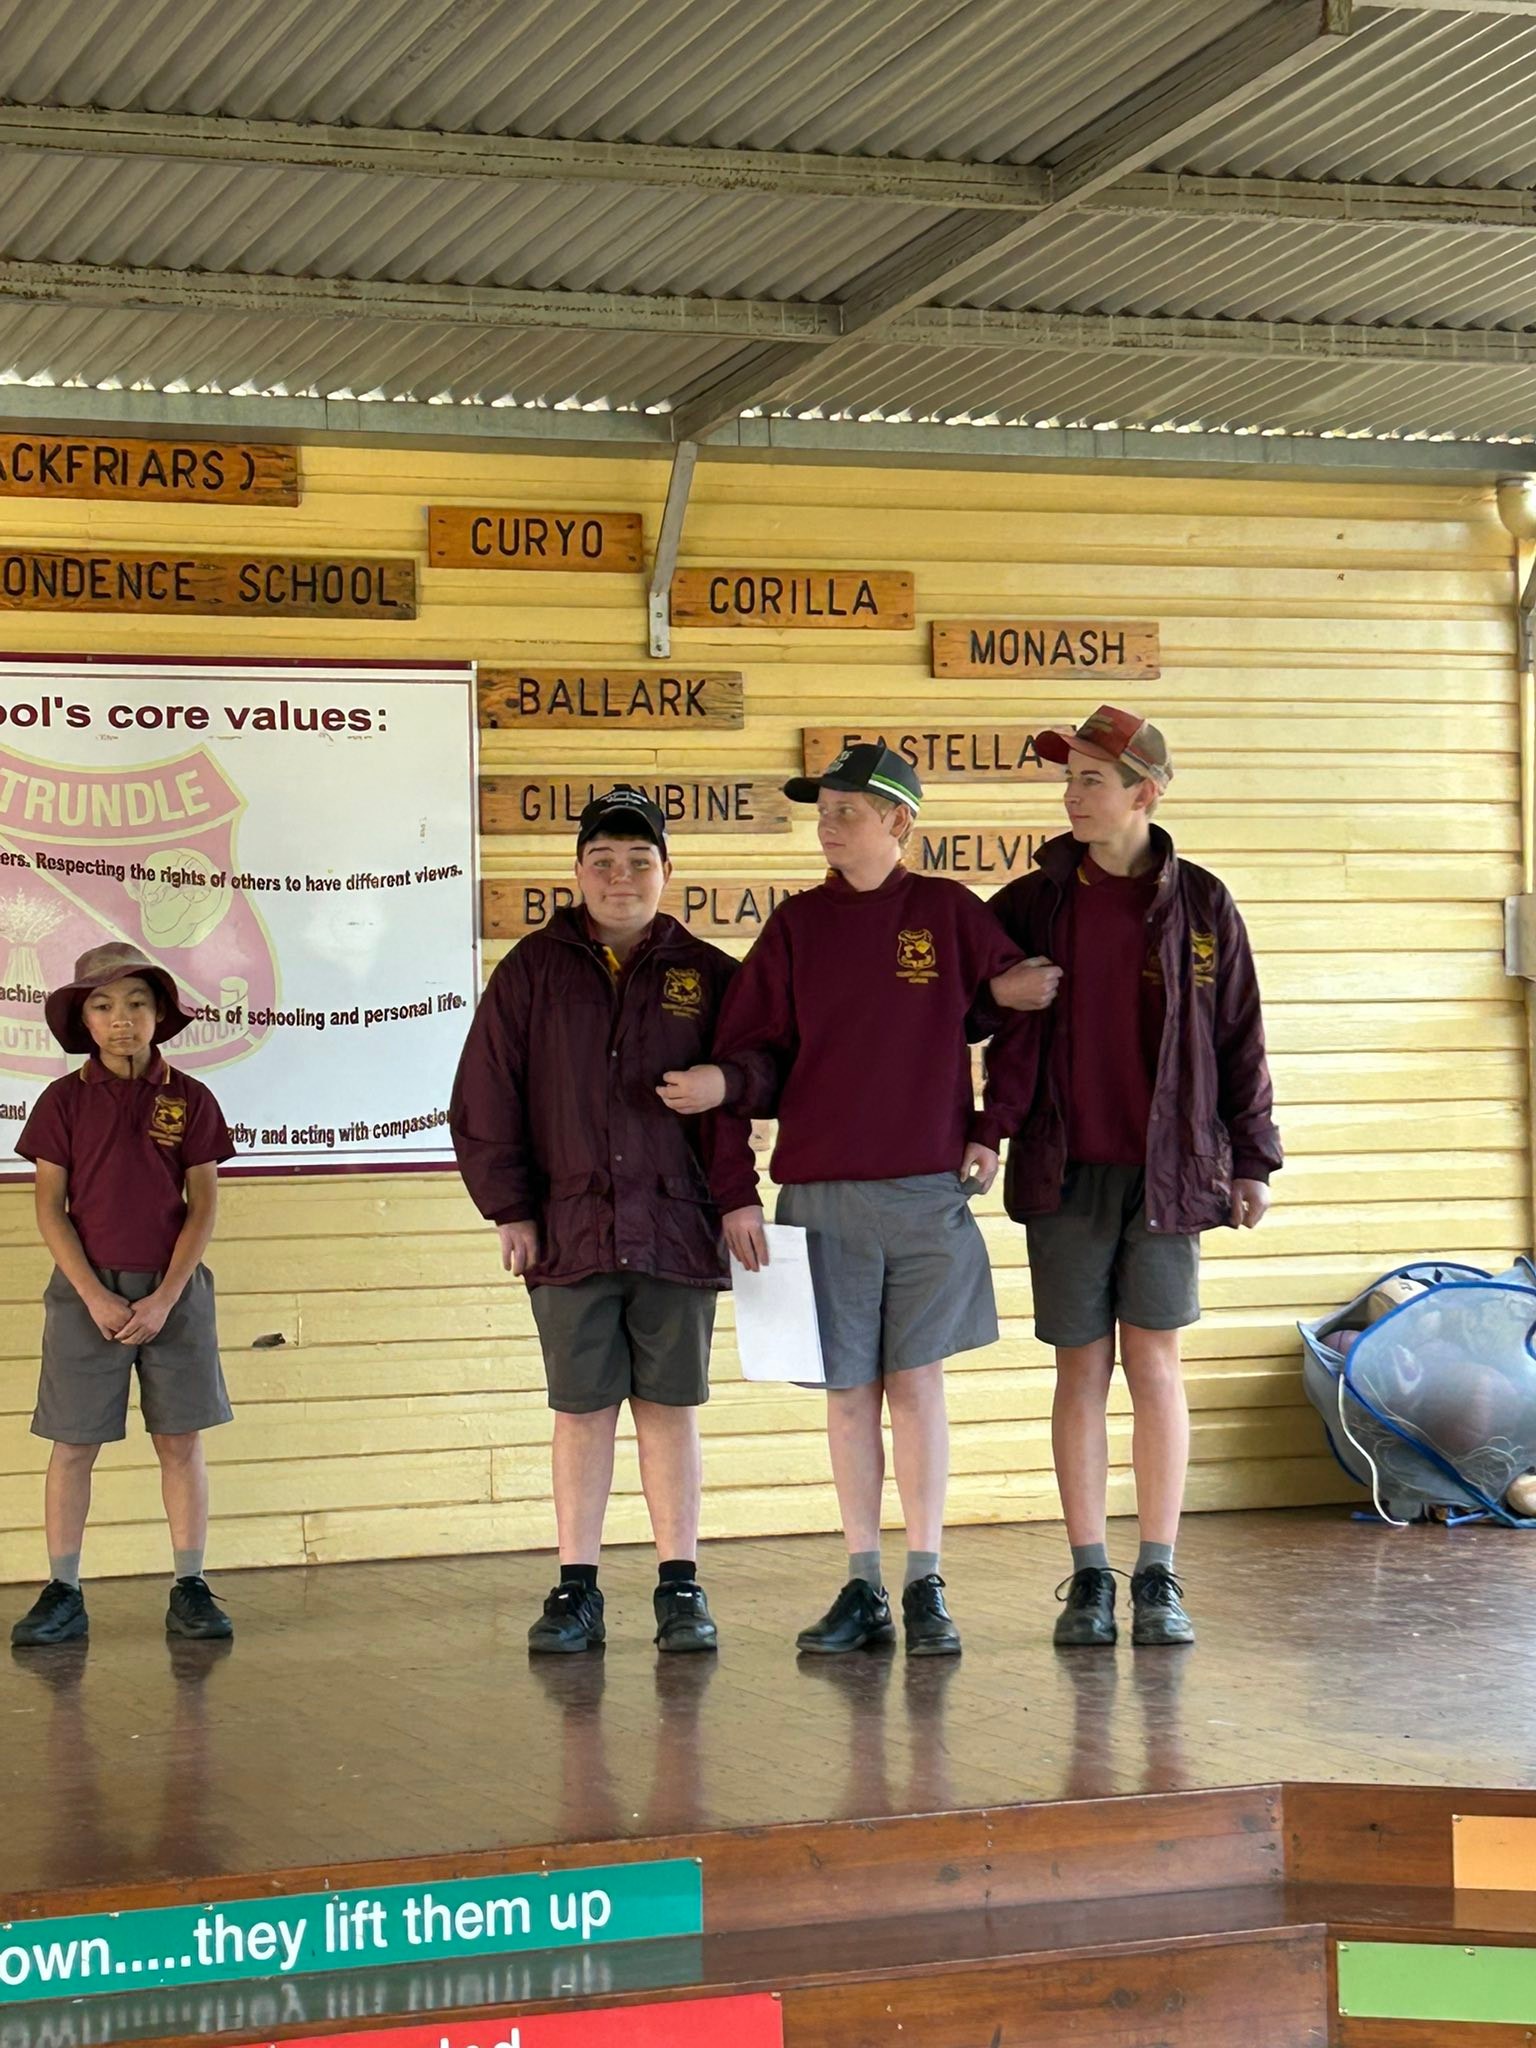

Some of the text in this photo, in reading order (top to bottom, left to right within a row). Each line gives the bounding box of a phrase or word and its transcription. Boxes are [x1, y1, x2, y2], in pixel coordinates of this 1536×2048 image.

[471, 516, 603, 558] CURYO
[3, 556, 398, 607] ONDENCE SCHOOL
[709, 576, 879, 616] CORILLA
[969, 628, 1125, 667] MONASH
[0, 696, 387, 732] ol's core values:
[519, 677, 707, 717] BALLARK
[842, 734, 1043, 770] STELLA
[0, 768, 210, 827] TRUNDLE
[521, 783, 754, 821] GILBINE
[36, 852, 125, 882] Respecting
[130, 863, 156, 882] the
[161, 866, 206, 888] rights
[210, 871, 227, 888] of
[231, 873, 281, 891] others
[285, 875, 301, 892] to
[305, 874, 341, 892] have
[346, 870, 411, 891] different
[415, 864, 463, 884] views.
[922, 834, 1046, 871] MELVI
[684, 885, 804, 924] PLAI
[194, 1004, 220, 1022] cts
[226, 1006, 242, 1024] of
[247, 1007, 325, 1031] schooling
[330, 1006, 359, 1026] and
[364, 996, 432, 1027] personal
[437, 991, 467, 1013] life.
[261, 1124, 287, 1144] and
[291, 1124, 335, 1148] acting
[338, 1120, 369, 1141] with
[324, 1898, 388, 1953] lift
[402, 1891, 531, 1946] them
[549, 1888, 611, 1941] up
